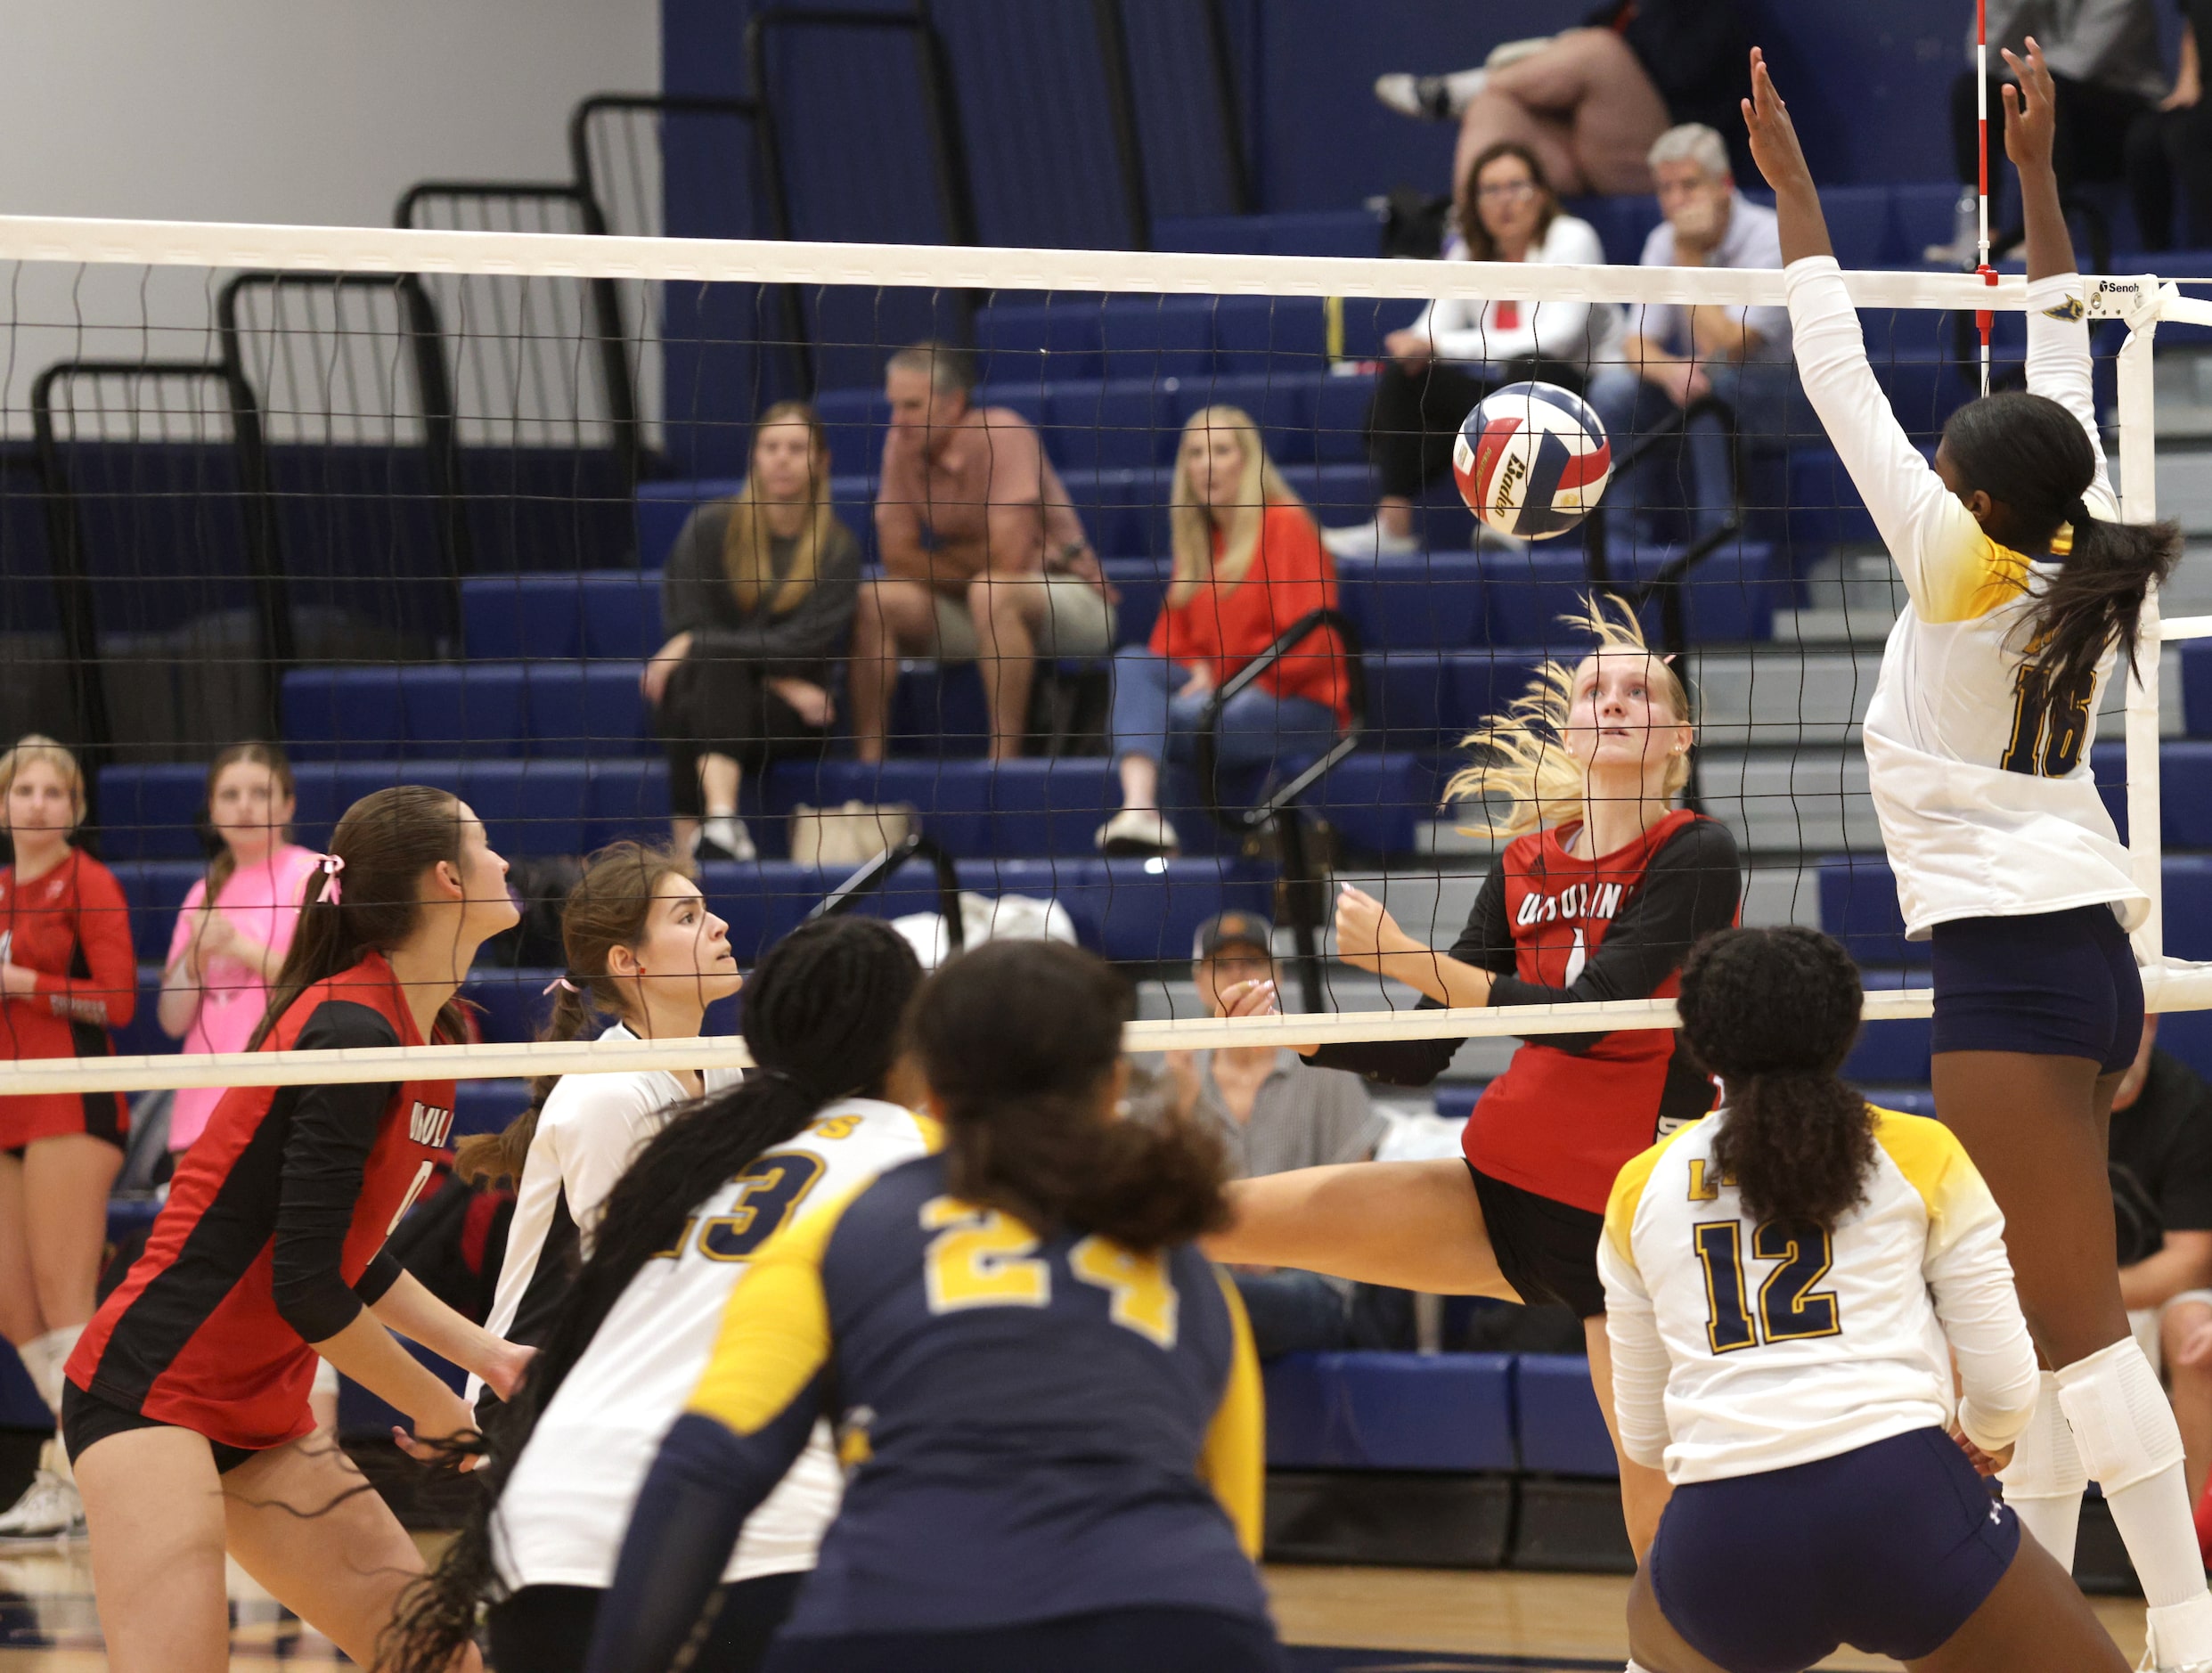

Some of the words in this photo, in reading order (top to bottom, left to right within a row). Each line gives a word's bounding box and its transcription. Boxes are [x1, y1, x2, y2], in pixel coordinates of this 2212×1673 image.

[2109, 282, 2140, 292] Senoh
[1494, 451, 1526, 518] Baden
[1999, 664, 2097, 779] 16
[1693, 1218, 1842, 1356] 12
